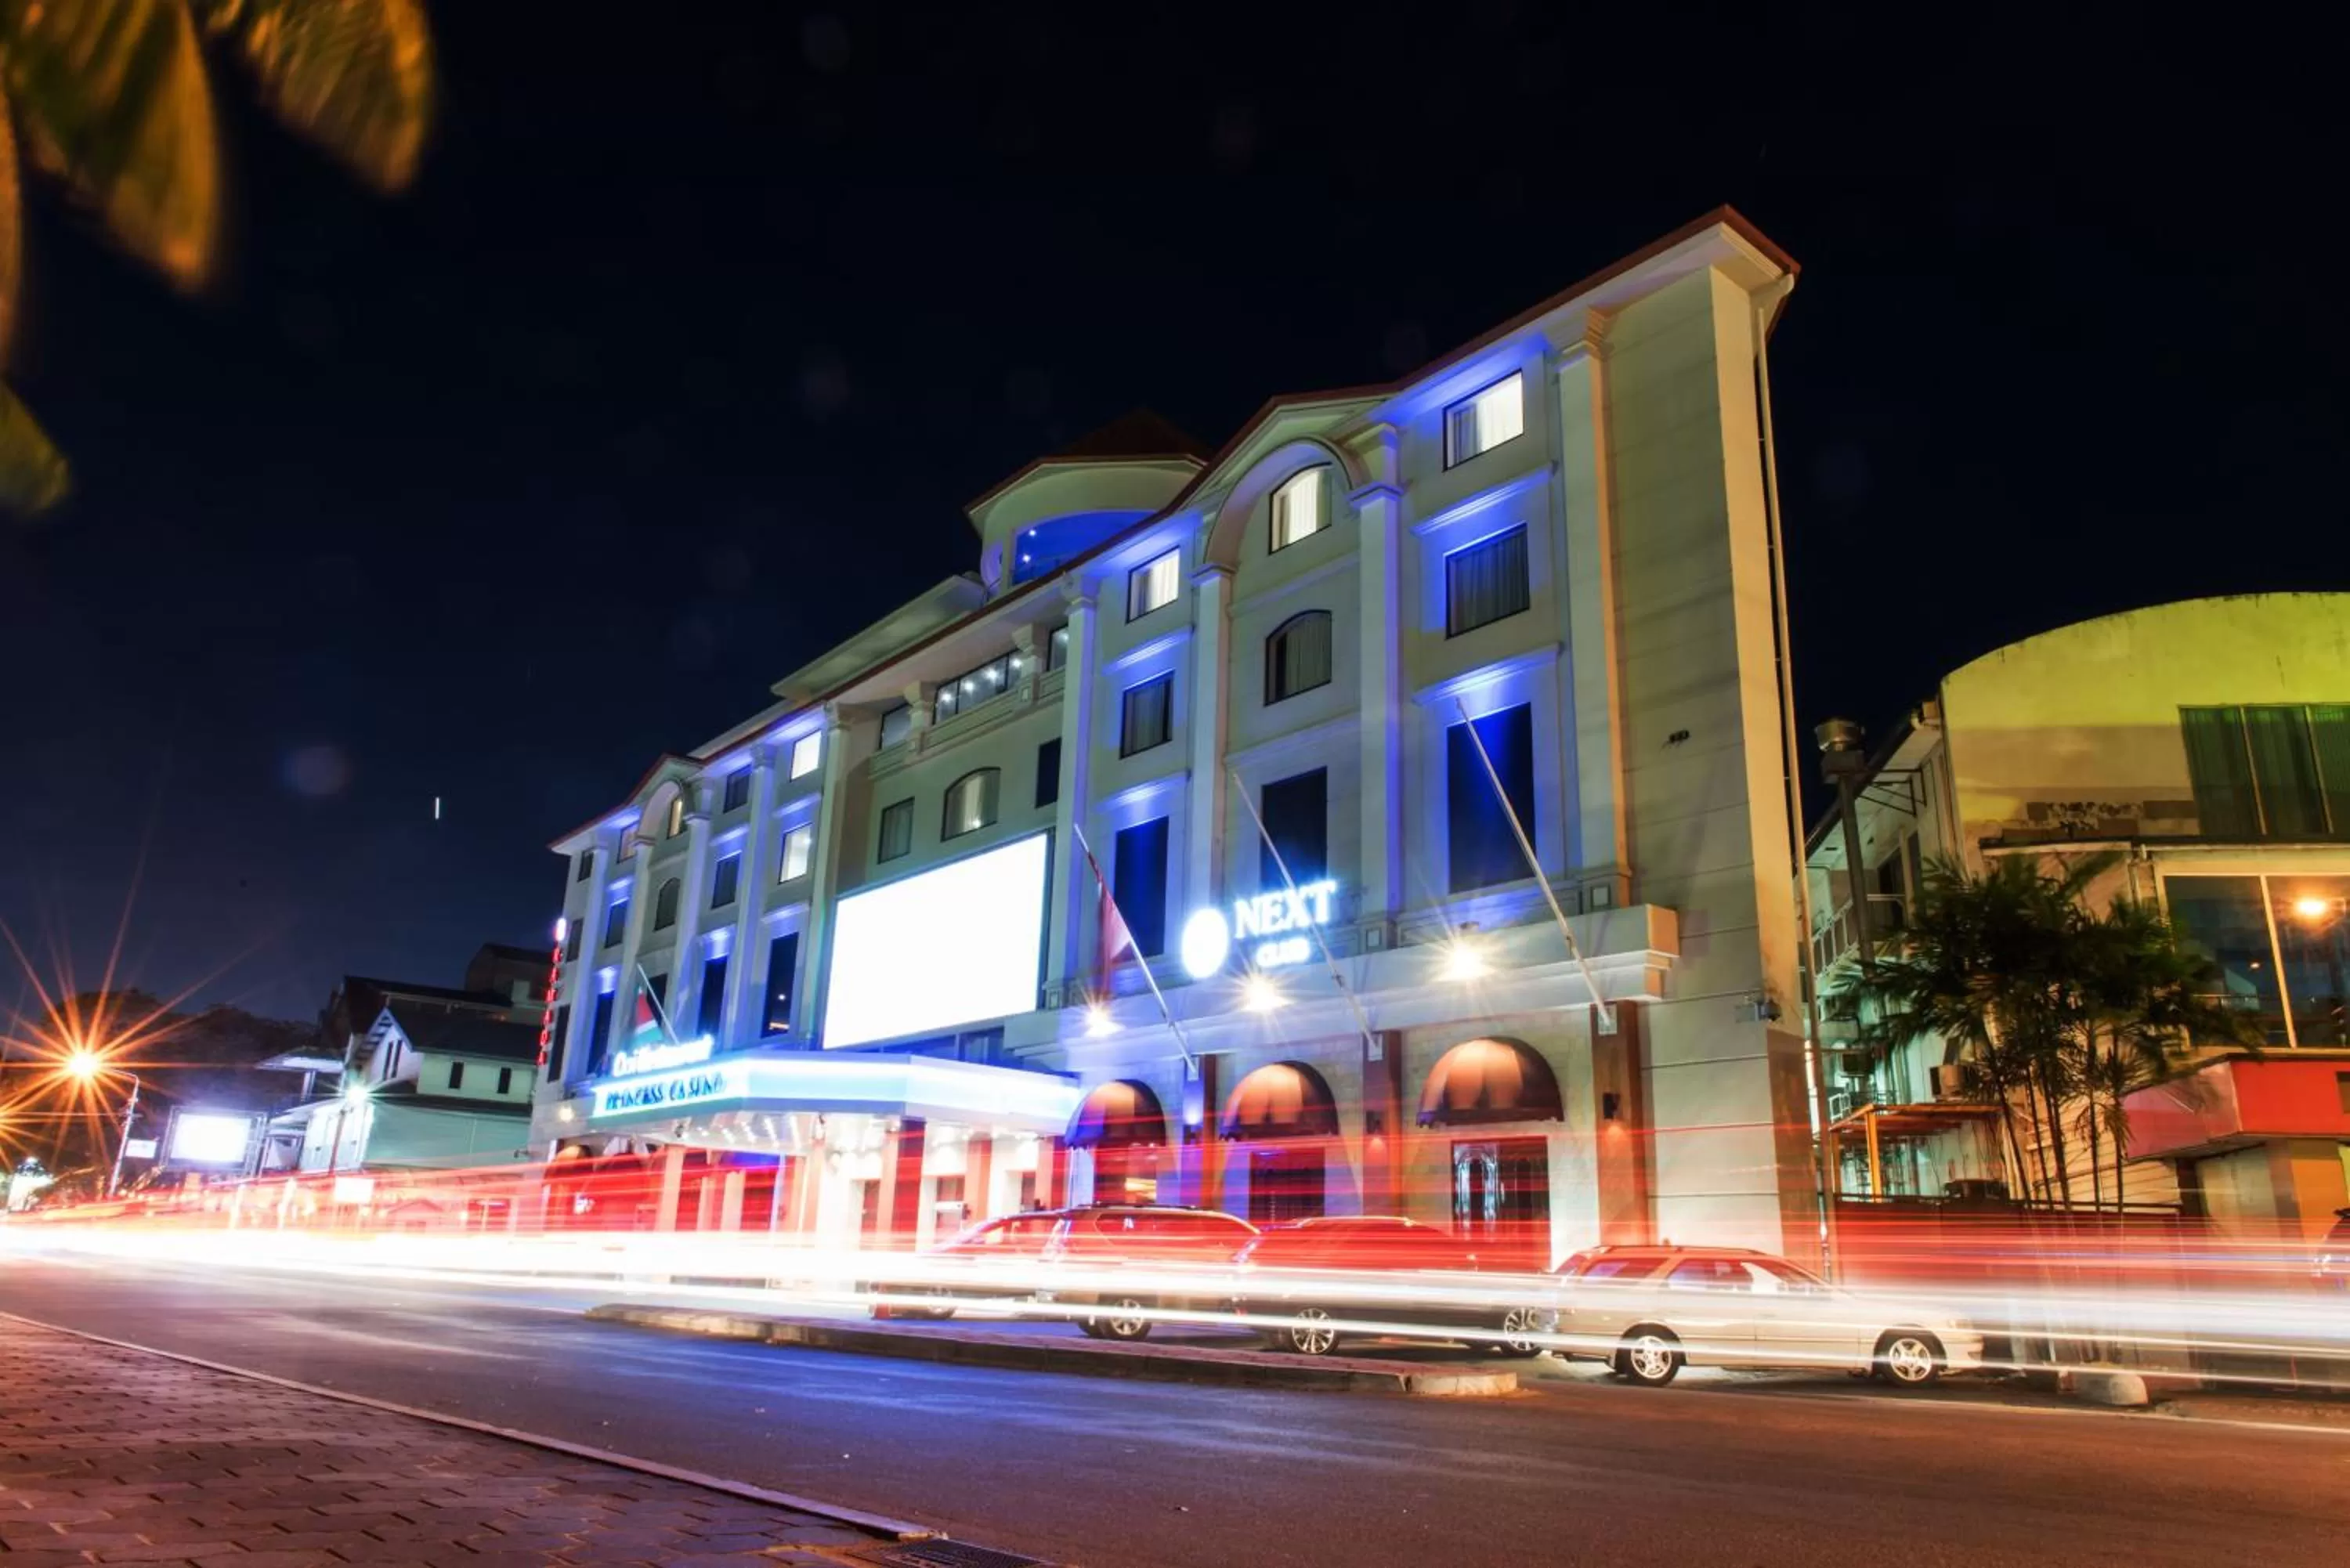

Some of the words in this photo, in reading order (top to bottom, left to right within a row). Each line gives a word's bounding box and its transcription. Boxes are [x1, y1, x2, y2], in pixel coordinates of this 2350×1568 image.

[1235, 880, 1336, 938] NEXT
[605, 1081, 665, 1111] PRINCESS
[669, 1071, 726, 1102] CASINO
